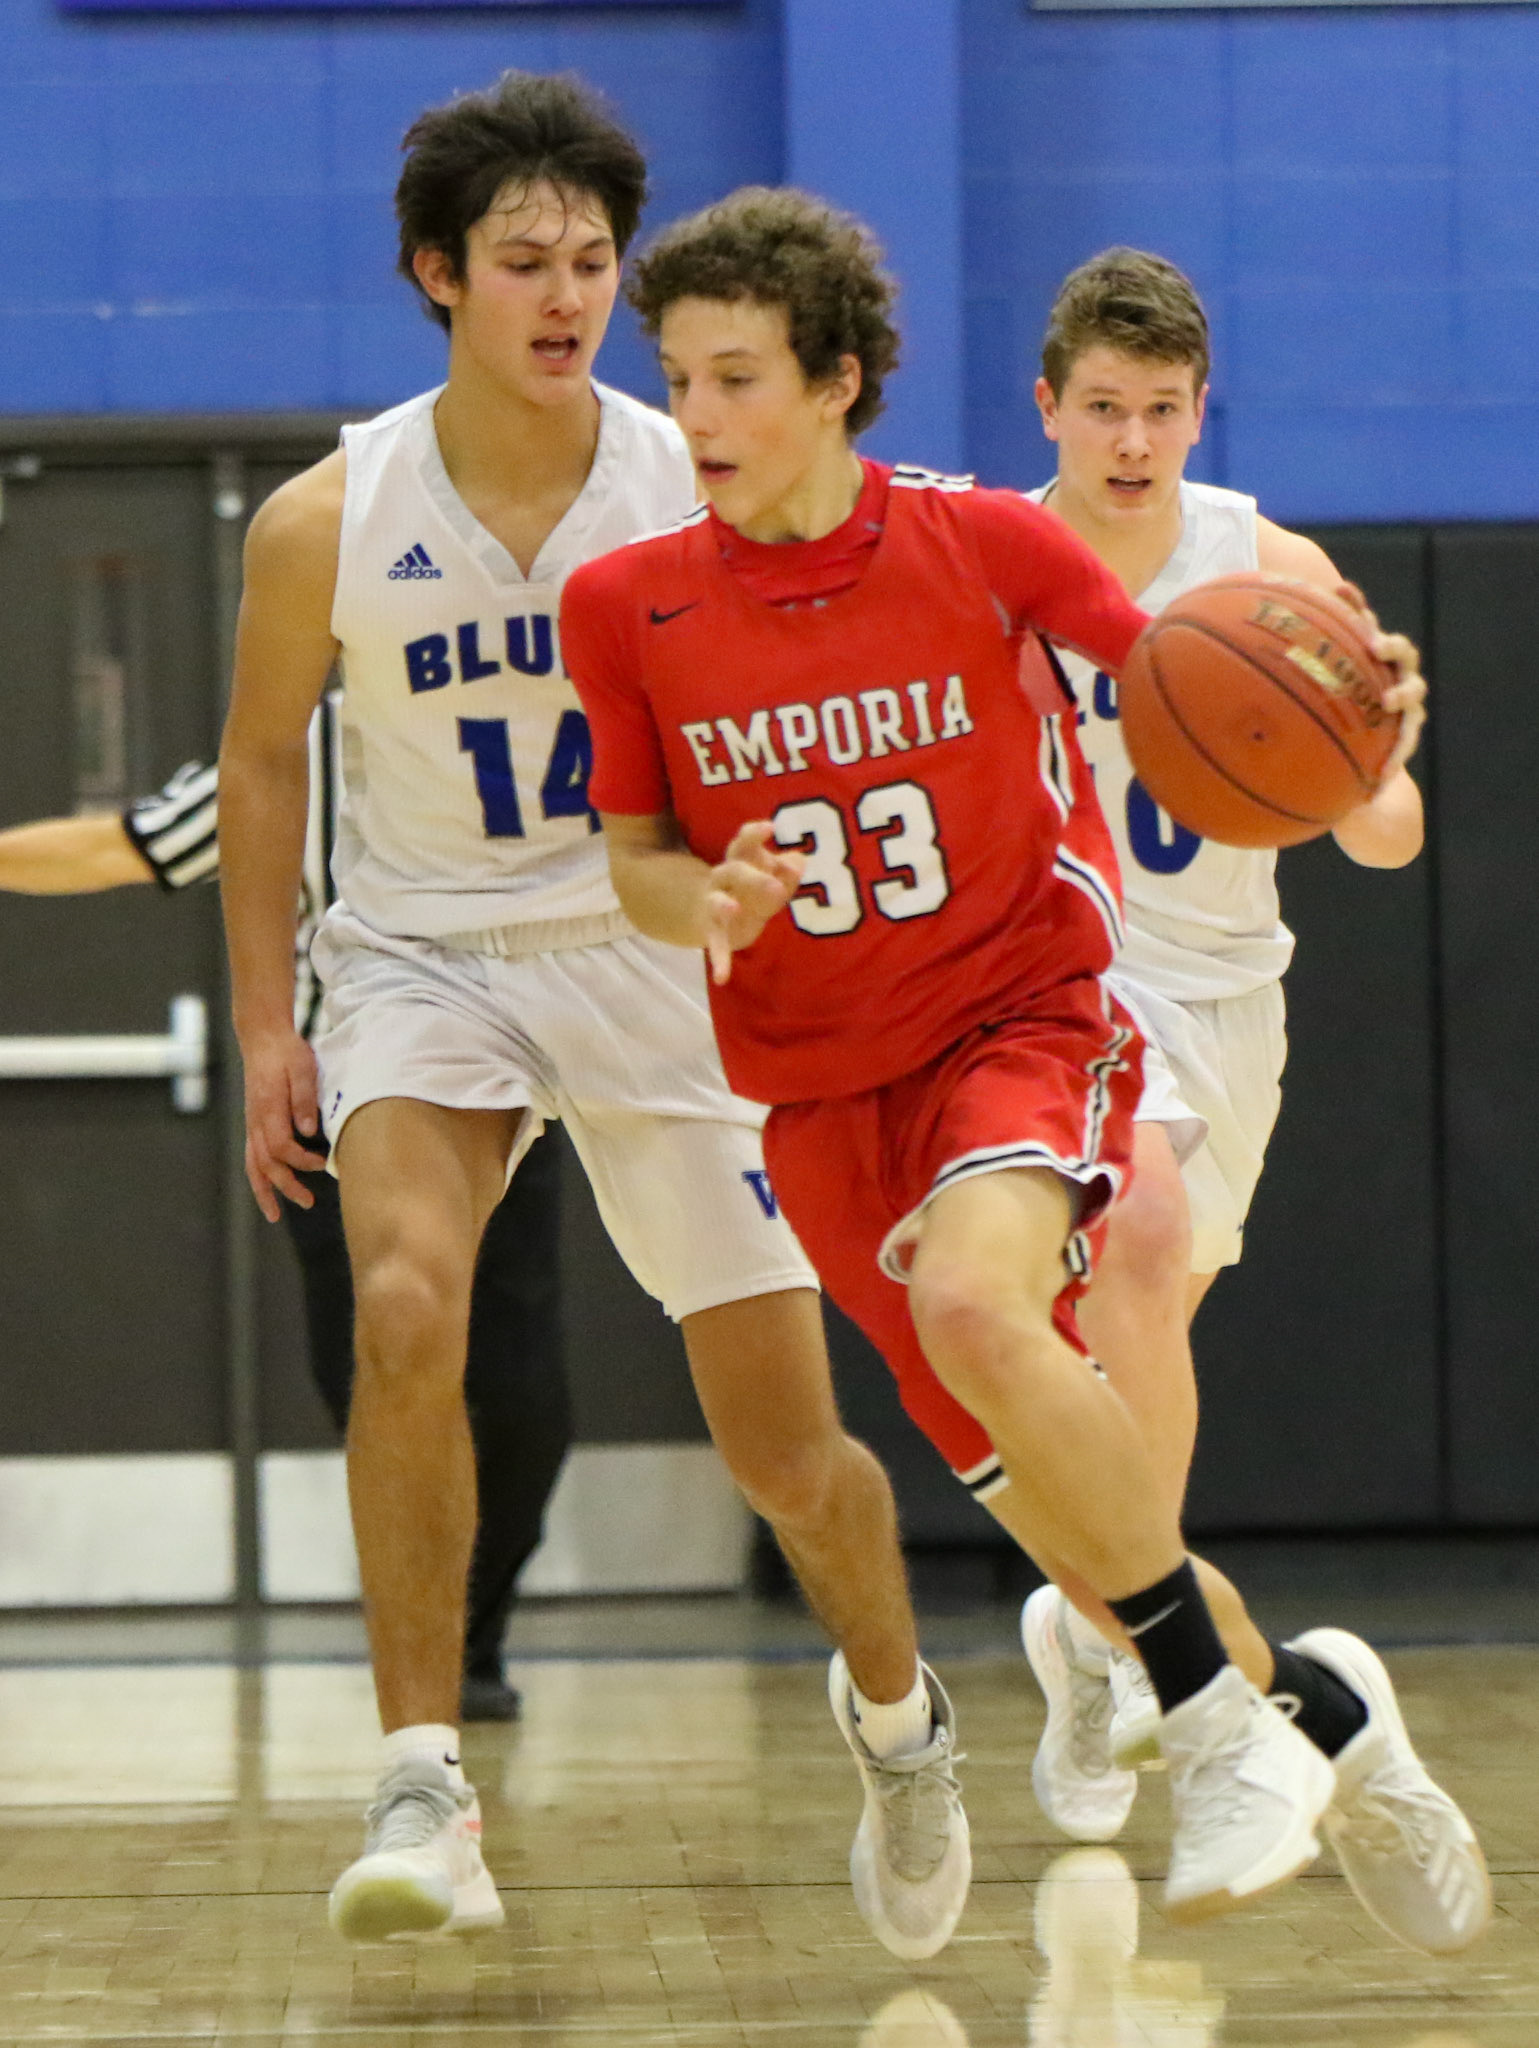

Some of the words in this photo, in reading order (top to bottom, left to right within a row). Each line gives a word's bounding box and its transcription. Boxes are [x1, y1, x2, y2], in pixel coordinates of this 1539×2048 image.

[388, 567, 442, 580] adidas
[404, 614, 573, 695] BLU
[456, 709, 603, 839] 14
[680, 674, 975, 786] EMPORIA
[772, 779, 952, 938] 33
